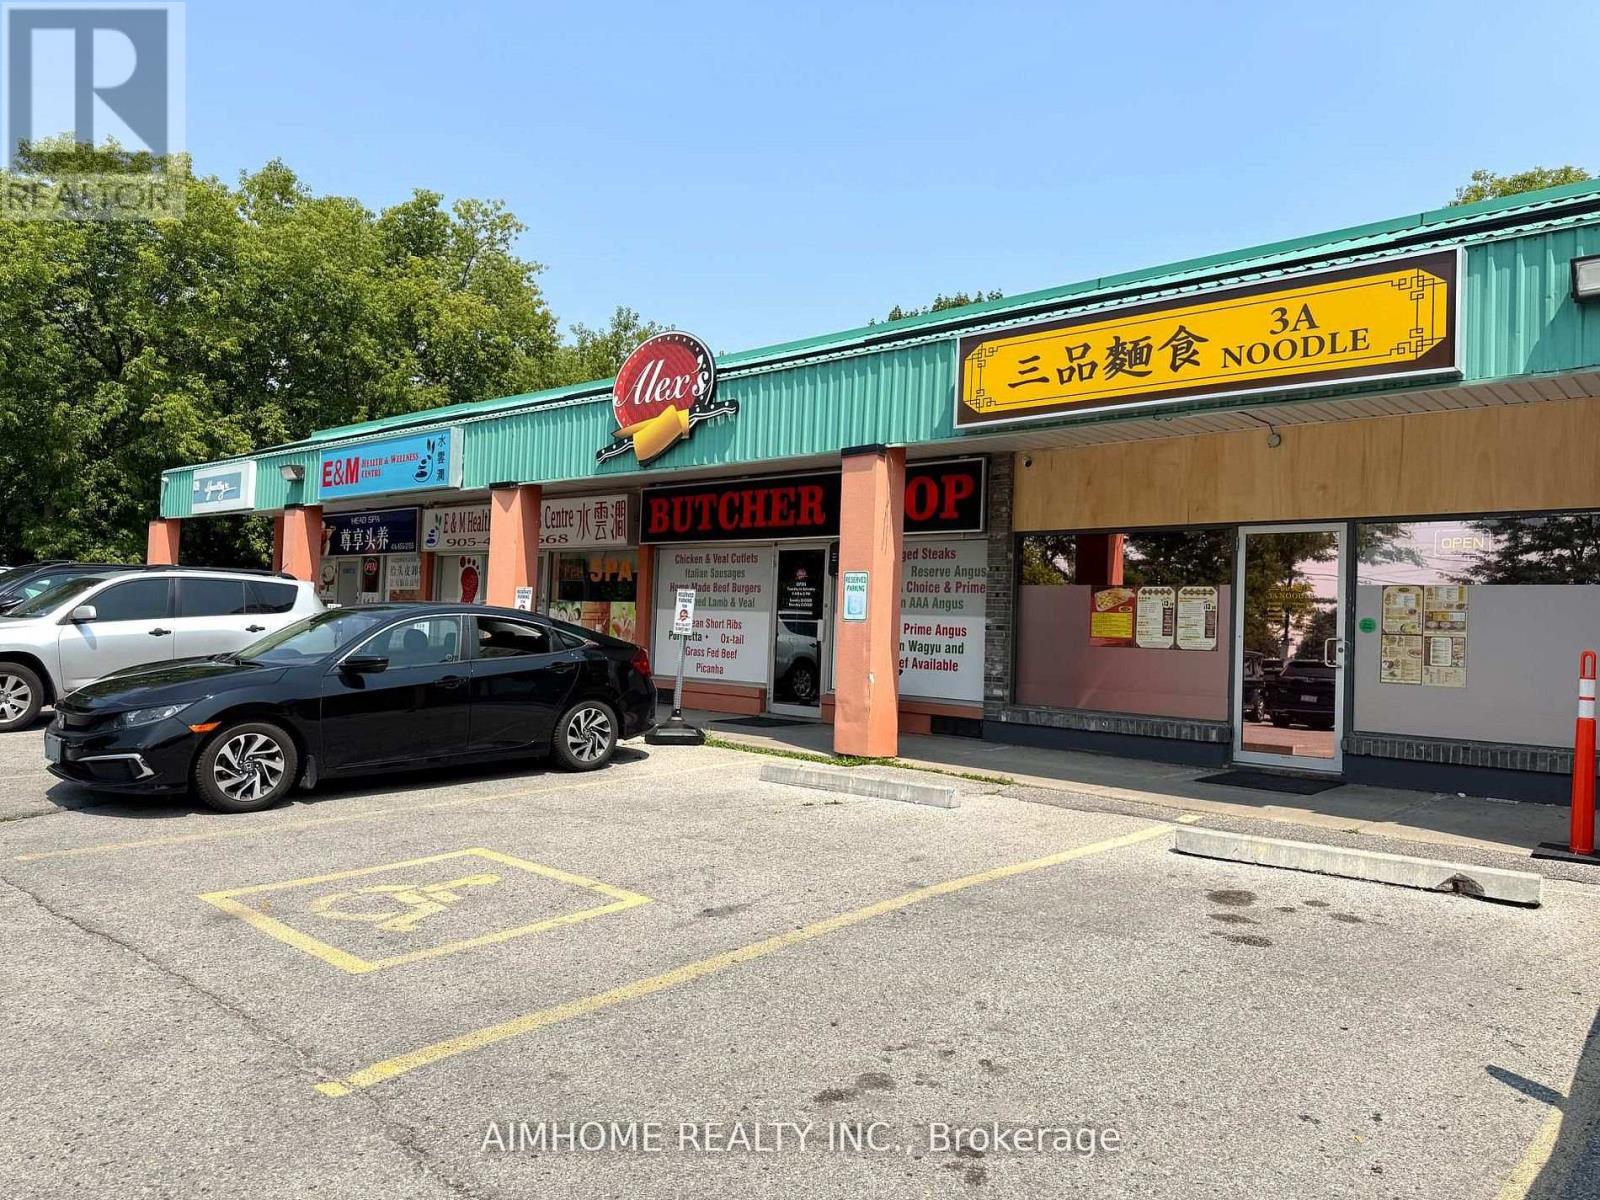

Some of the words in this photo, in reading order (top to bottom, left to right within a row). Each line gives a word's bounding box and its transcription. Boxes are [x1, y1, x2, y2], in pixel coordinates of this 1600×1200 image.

[1269, 303, 1319, 335] 3A
[1221, 328, 1370, 368] NOODLE
[1008, 325, 1209, 390] 三品麵食
[614, 354, 710, 407] Alex's
[322, 456, 359, 487] E&M
[649, 484, 826, 534] BUTCHER
[905, 474, 975, 522] OP
[351, 516, 366, 525] HEAD
[368, 515, 381, 524] SPA
[444, 512, 449, 534] E
[450, 511, 457, 534] &
[459, 511, 465, 533] M
[545, 505, 573, 530] Centre
[1441, 537, 1484, 549] OPEN
[675, 553, 704, 565] Chicken
[705, 554, 711, 563] &
[713, 553, 729, 564] Veal
[731, 553, 758, 564] Cutlets
[922, 547, 956, 560] Steaks
[590, 559, 633, 582] SPA
[685, 568, 708, 578] Italian
[710, 568, 745, 580] Sausages
[911, 566, 951, 578] Reserve
[954, 565, 987, 579] Angus
[845, 576, 866, 584] RESERVED
[691, 582, 710, 593] Made
[713, 582, 730, 593] Beef
[732, 582, 761, 595] Burgers
[907, 581, 940, 593] Choice
[944, 581, 951, 593] &
[955, 581, 986, 594] Prime
[708, 598, 728, 608] Lamb
[730, 598, 736, 608] &
[739, 598, 755, 608] Veal
[909, 597, 929, 609] AAA
[932, 597, 964, 611] Angus
[706, 618, 725, 629] Short
[726, 619, 742, 629] Ribs
[904, 623, 931, 635] Prime
[935, 623, 967, 638] Angus
[720, 633, 744, 644] Ox-tail
[685, 646, 705, 657] Grass
[706, 647, 719, 658] Fed
[721, 648, 737, 659] Beef
[908, 640, 941, 655] Wagyu
[945, 642, 964, 654] and
[696, 663, 724, 675] Picanha
[912, 657, 959, 672] Available
